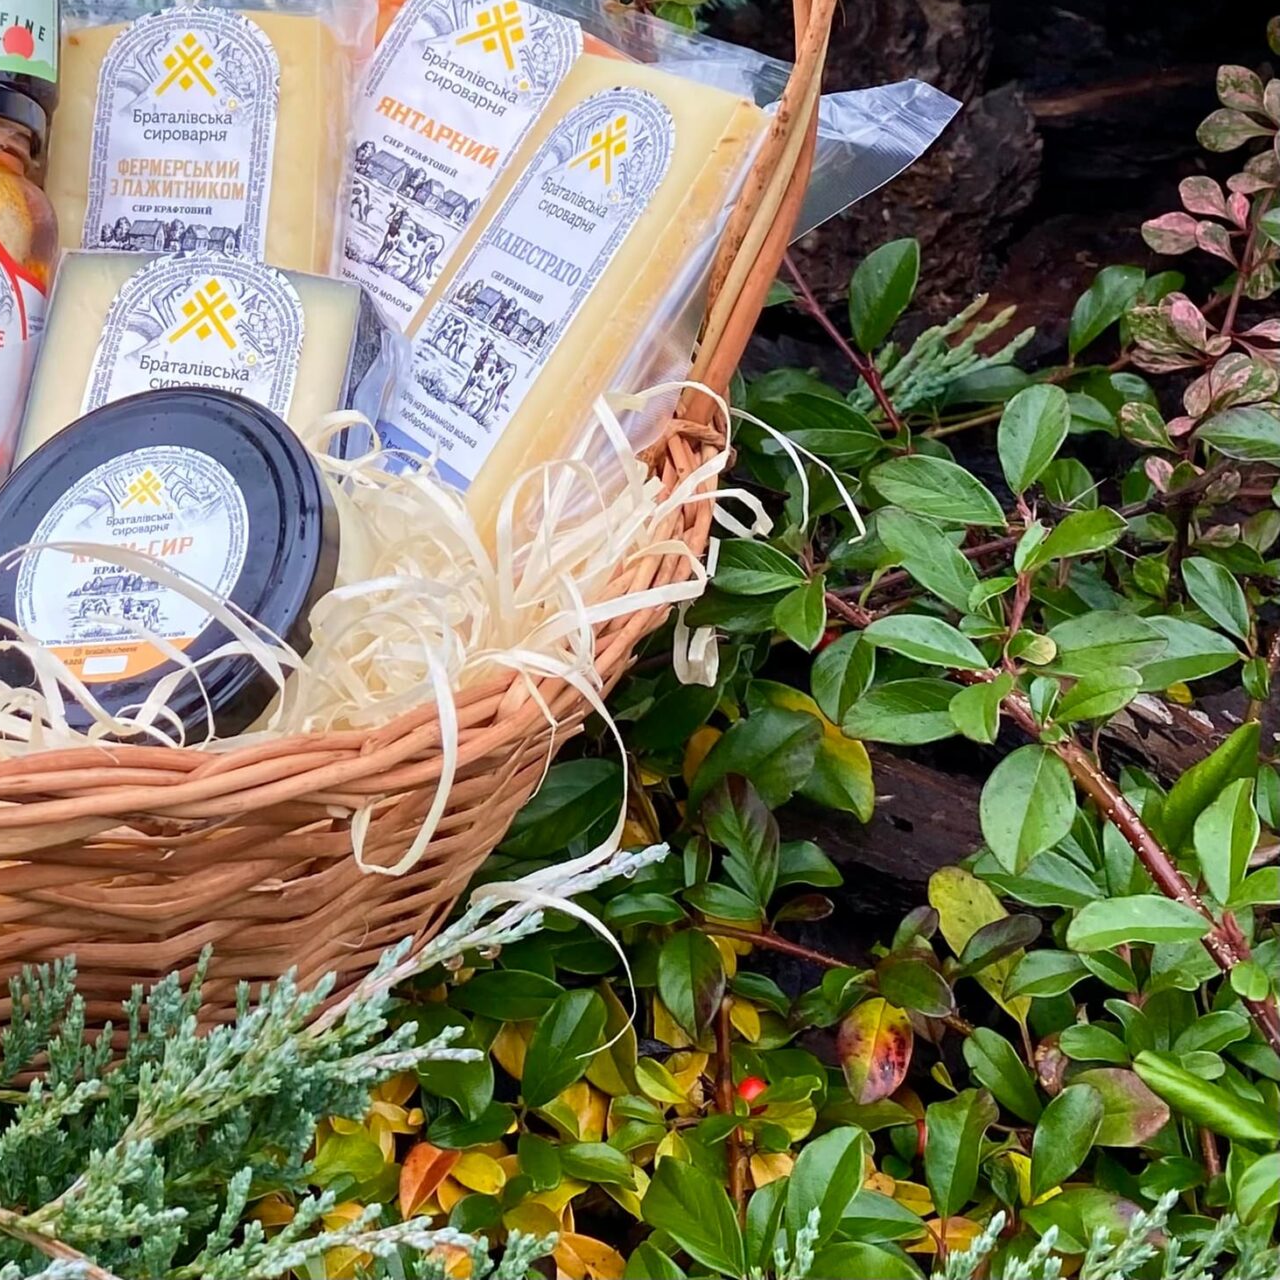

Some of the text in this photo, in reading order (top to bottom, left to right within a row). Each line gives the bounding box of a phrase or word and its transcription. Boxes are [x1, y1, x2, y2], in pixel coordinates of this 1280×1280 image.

[421, 46, 519, 104] Браталівська
[424, 69, 507, 117] сироварня
[132, 109, 233, 127] Браталівська
[143, 127, 228, 144] сироварня
[375, 95, 501, 170] ЯНТАРНИЙ
[382, 134, 404, 152] СИР
[117, 158, 240, 180] ФЕРМЕРСЬКИЙ
[122, 179, 245, 201] ПАЖИТНИКОМ
[540, 176, 609, 219] Браталівська
[132, 204, 153, 213] СИР
[538, 199, 597, 233] сироварня
[490, 227, 582, 287] КАНЕСТРАТО
[379, 290, 414, 313] молока
[139, 354, 250, 381] Браталівська
[106, 512, 174, 527] Браталівська
[112, 523, 170, 536] сироварня
